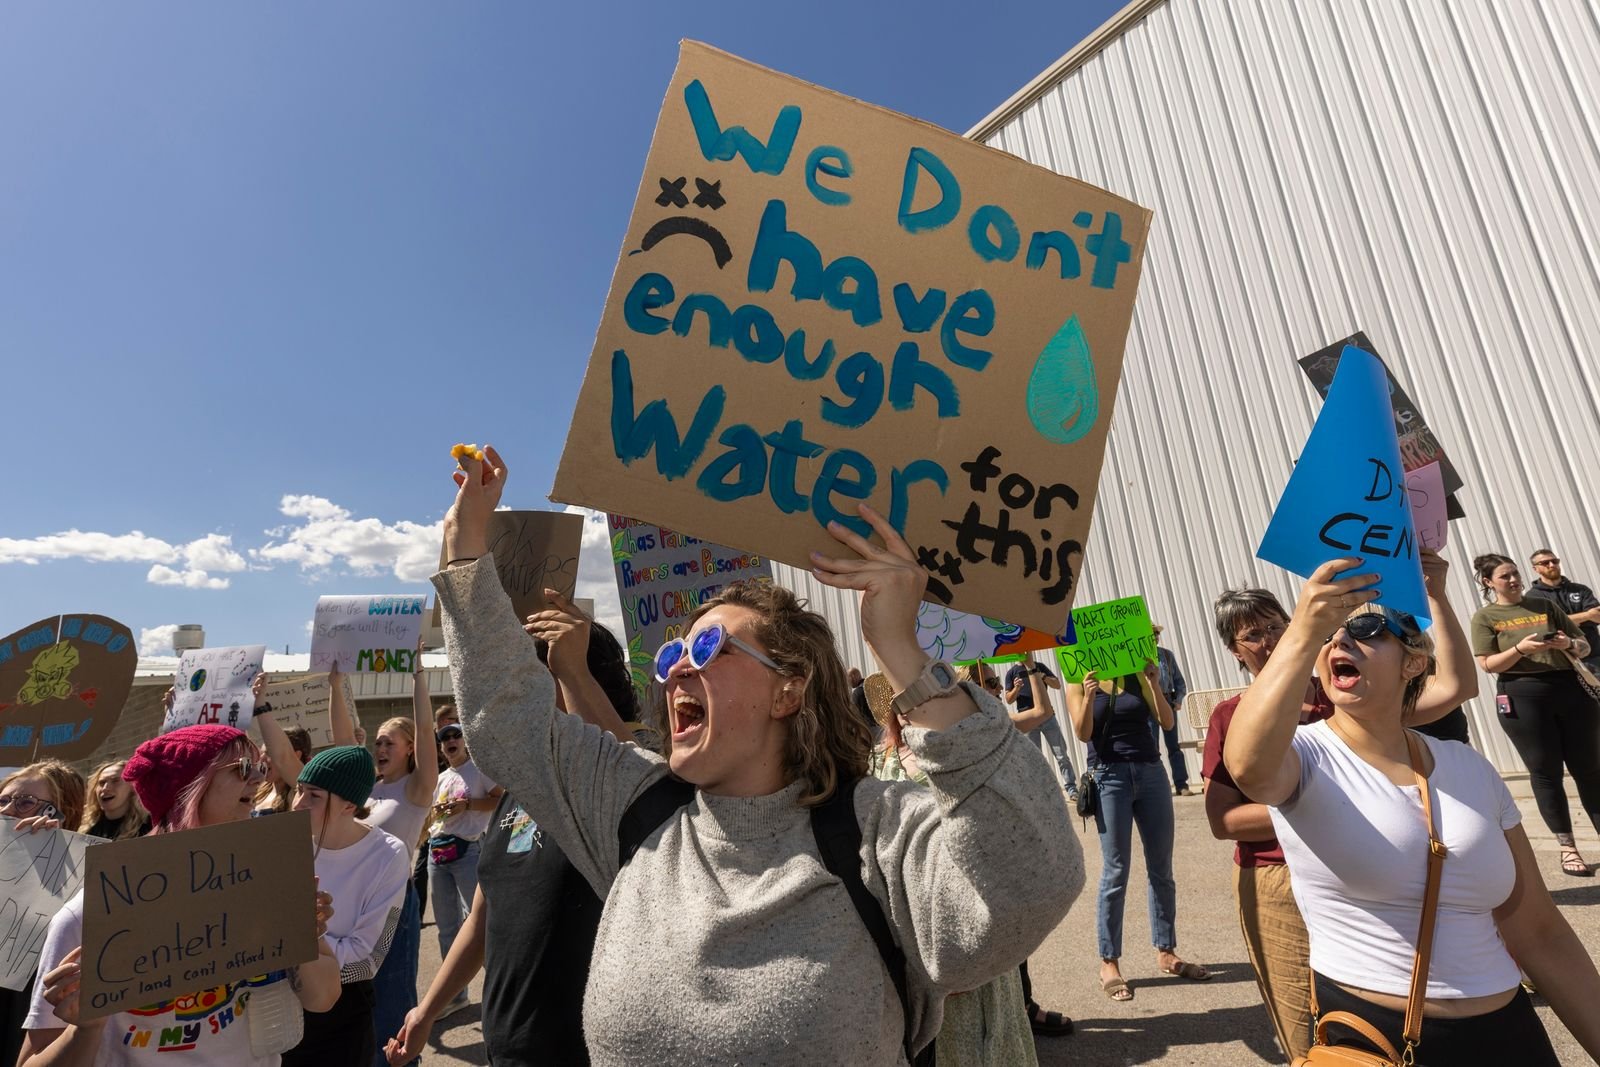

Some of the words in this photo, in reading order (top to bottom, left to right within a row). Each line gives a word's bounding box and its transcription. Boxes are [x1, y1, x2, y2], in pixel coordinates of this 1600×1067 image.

[684, 78, 854, 206] We
[897, 146, 1133, 290] Don't
[747, 199, 997, 372] have
[623, 272, 961, 429] enough
[611, 349, 949, 540] Water
[960, 445, 1080, 520] for
[626, 528, 656, 554] has
[942, 501, 1083, 603] this
[1318, 511, 1414, 561] CEN
[621, 559, 670, 589] Rivers
[673, 559, 700, 577] are
[701, 548, 761, 578] Poisoned
[368, 597, 423, 616] WATER
[623, 592, 659, 632] YOU
[1071, 606, 1106, 629] MART
[1110, 599, 1142, 620] GROWTH
[1061, 642, 1118, 677] DRAIN
[197, 703, 223, 724] AI
[190, 849, 254, 894] Data
[97, 912, 228, 984] Center!
[139, 973, 172, 994] land
[226, 948, 265, 972] afford
[271, 938, 284, 959] it
